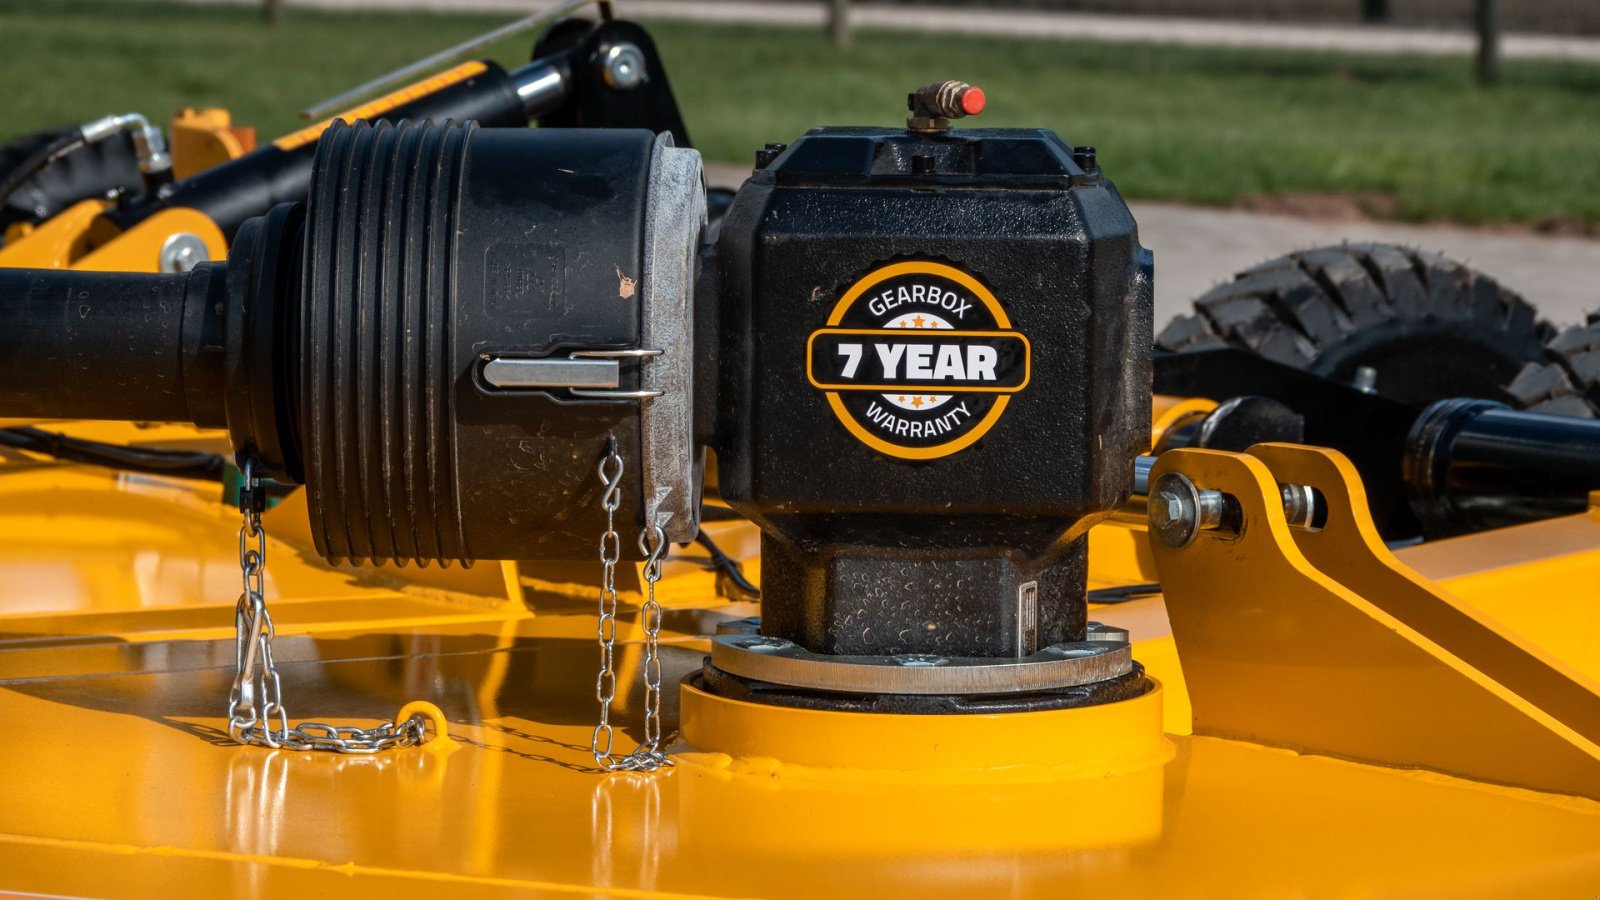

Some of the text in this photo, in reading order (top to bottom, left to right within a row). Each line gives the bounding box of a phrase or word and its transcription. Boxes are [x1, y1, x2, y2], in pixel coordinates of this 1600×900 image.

[868, 284, 973, 319] GEARBOX
[838, 343, 998, 381] 7 YEAR
[865, 401, 972, 438] WARRANTY
